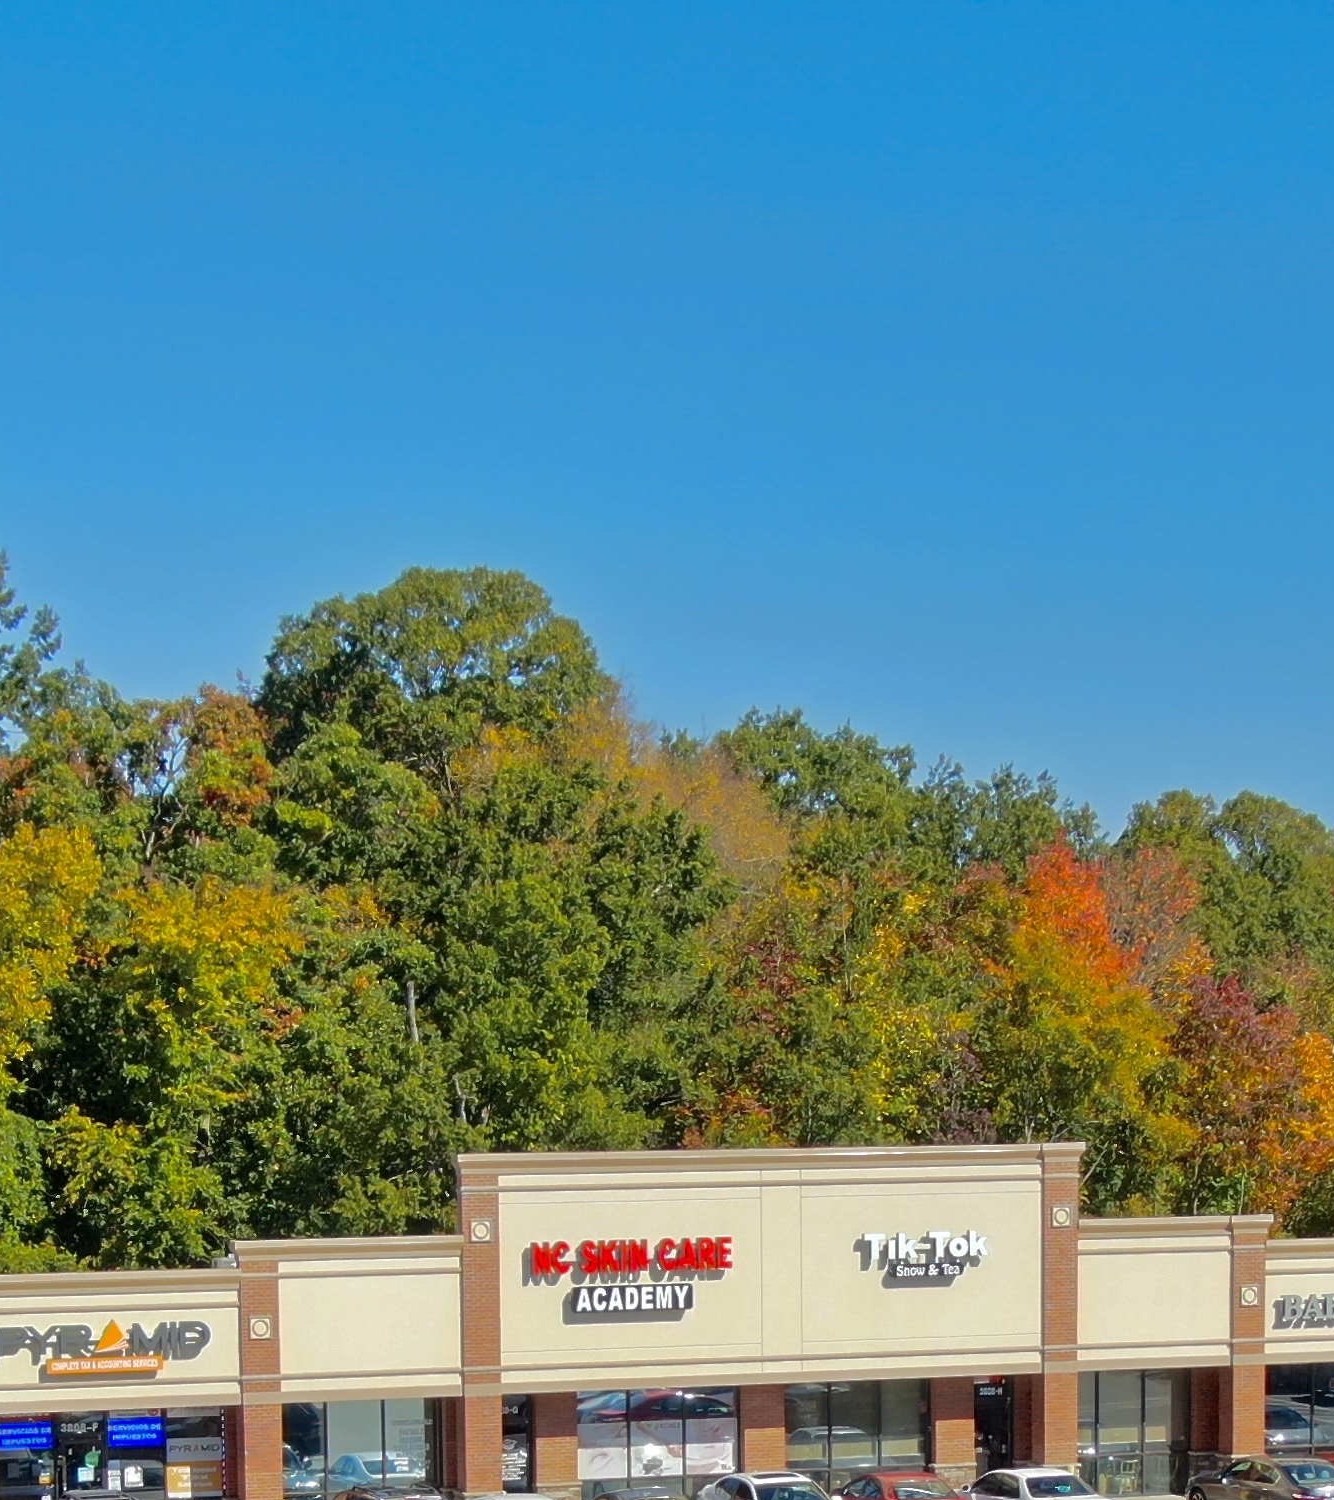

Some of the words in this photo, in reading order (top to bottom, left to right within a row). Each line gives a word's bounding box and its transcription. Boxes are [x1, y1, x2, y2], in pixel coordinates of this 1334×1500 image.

[530, 1241, 571, 1275] NC
[580, 1239, 648, 1274] SKIN
[658, 1237, 732, 1271] CARE
[896, 1265, 925, 1276] Snow
[929, 1264, 939, 1275] &
[941, 1263, 960, 1275] Tea
[576, 1285, 689, 1312] ACADEMY
[51, 1361, 80, 1371] COMPLETE
[80, 1361, 91, 1369] TAX
[97, 1360, 132, 1369] ACCOUNTING
[132, 1359, 158, 1368] SERVICES
